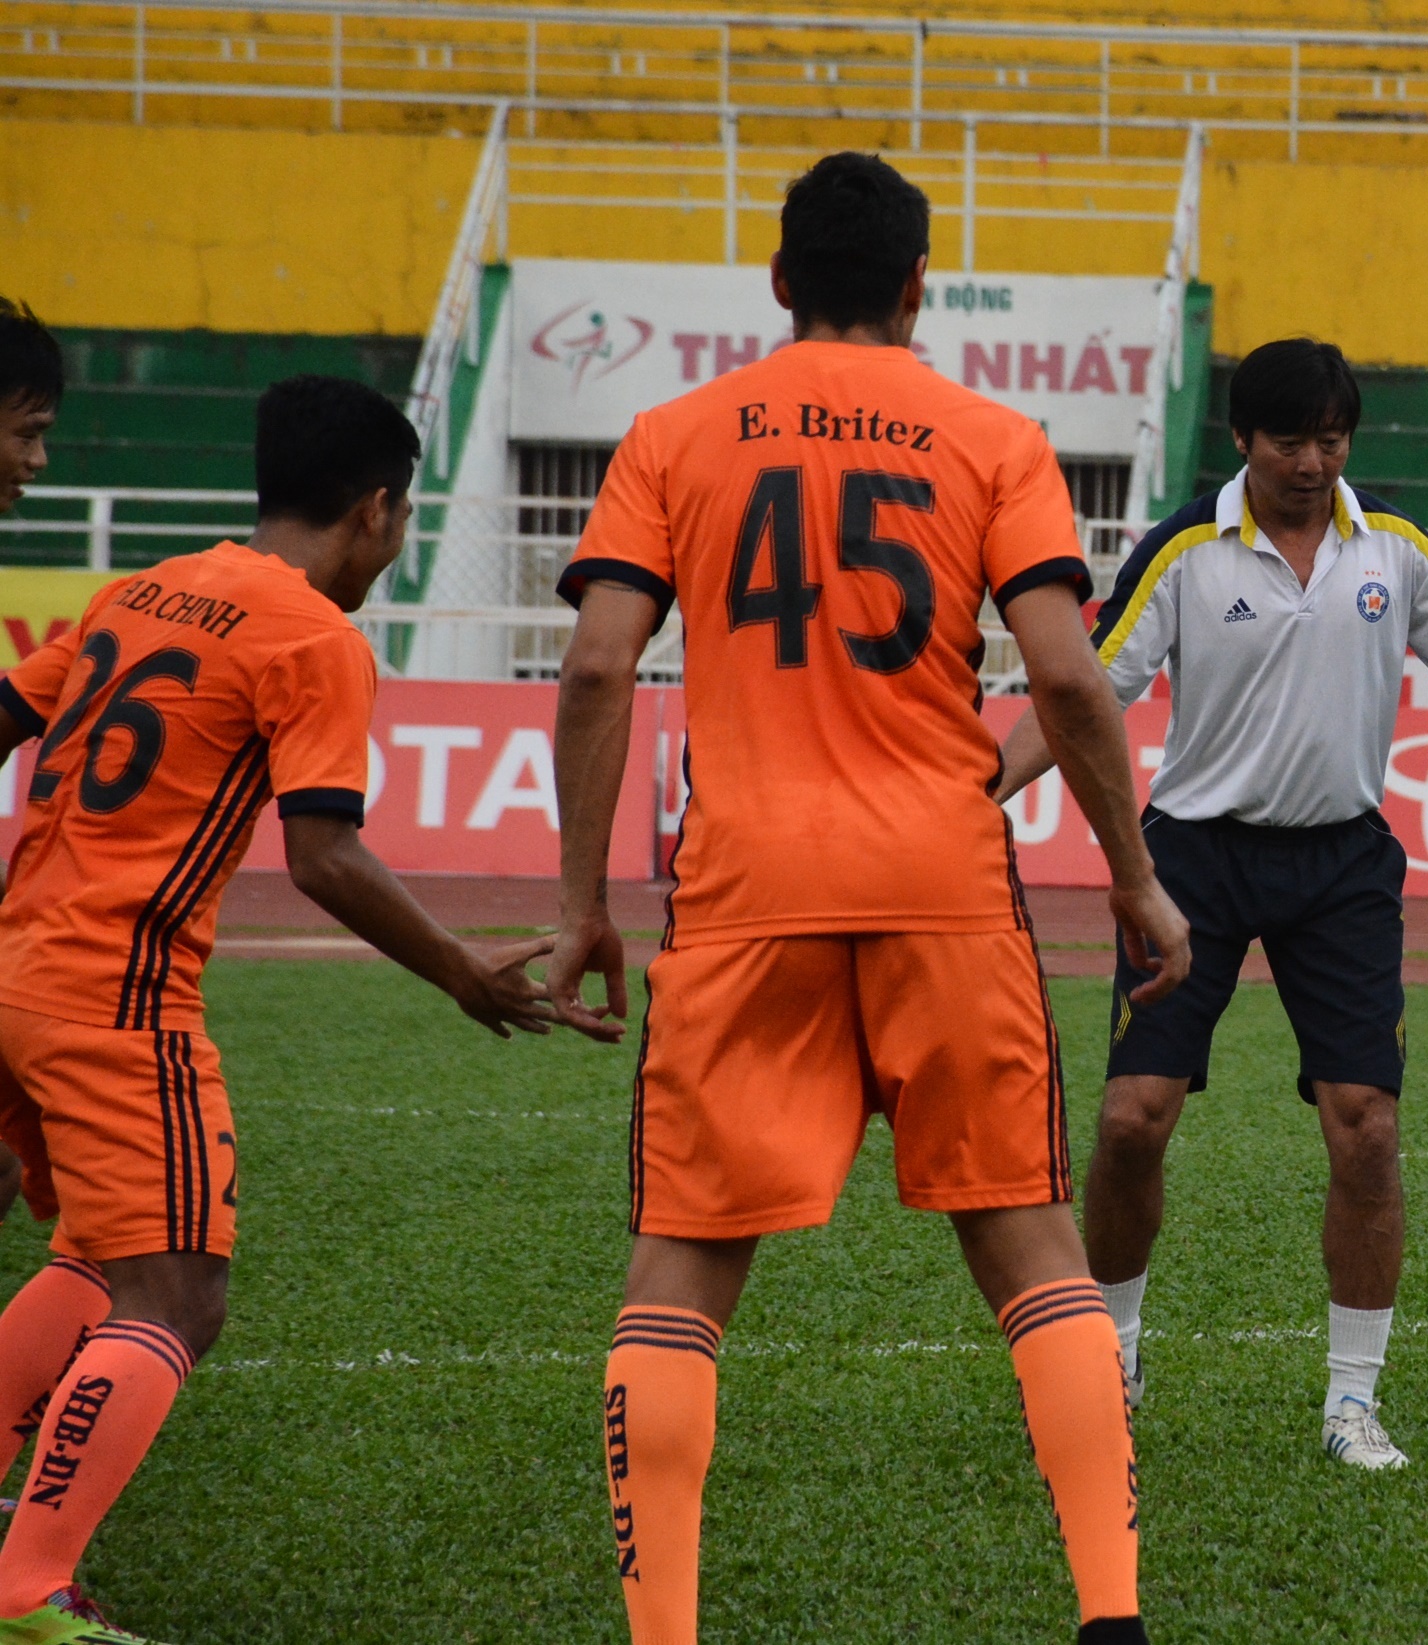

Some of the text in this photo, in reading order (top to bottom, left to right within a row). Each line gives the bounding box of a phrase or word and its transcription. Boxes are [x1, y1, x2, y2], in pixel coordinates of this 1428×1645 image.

[963, 327, 1154, 395] NHẤT
[737, 403, 935, 452] E. Britez
[726, 466, 937, 675] 45
[1224, 611, 1257, 623] adidas
[27, 628, 201, 815] 26
